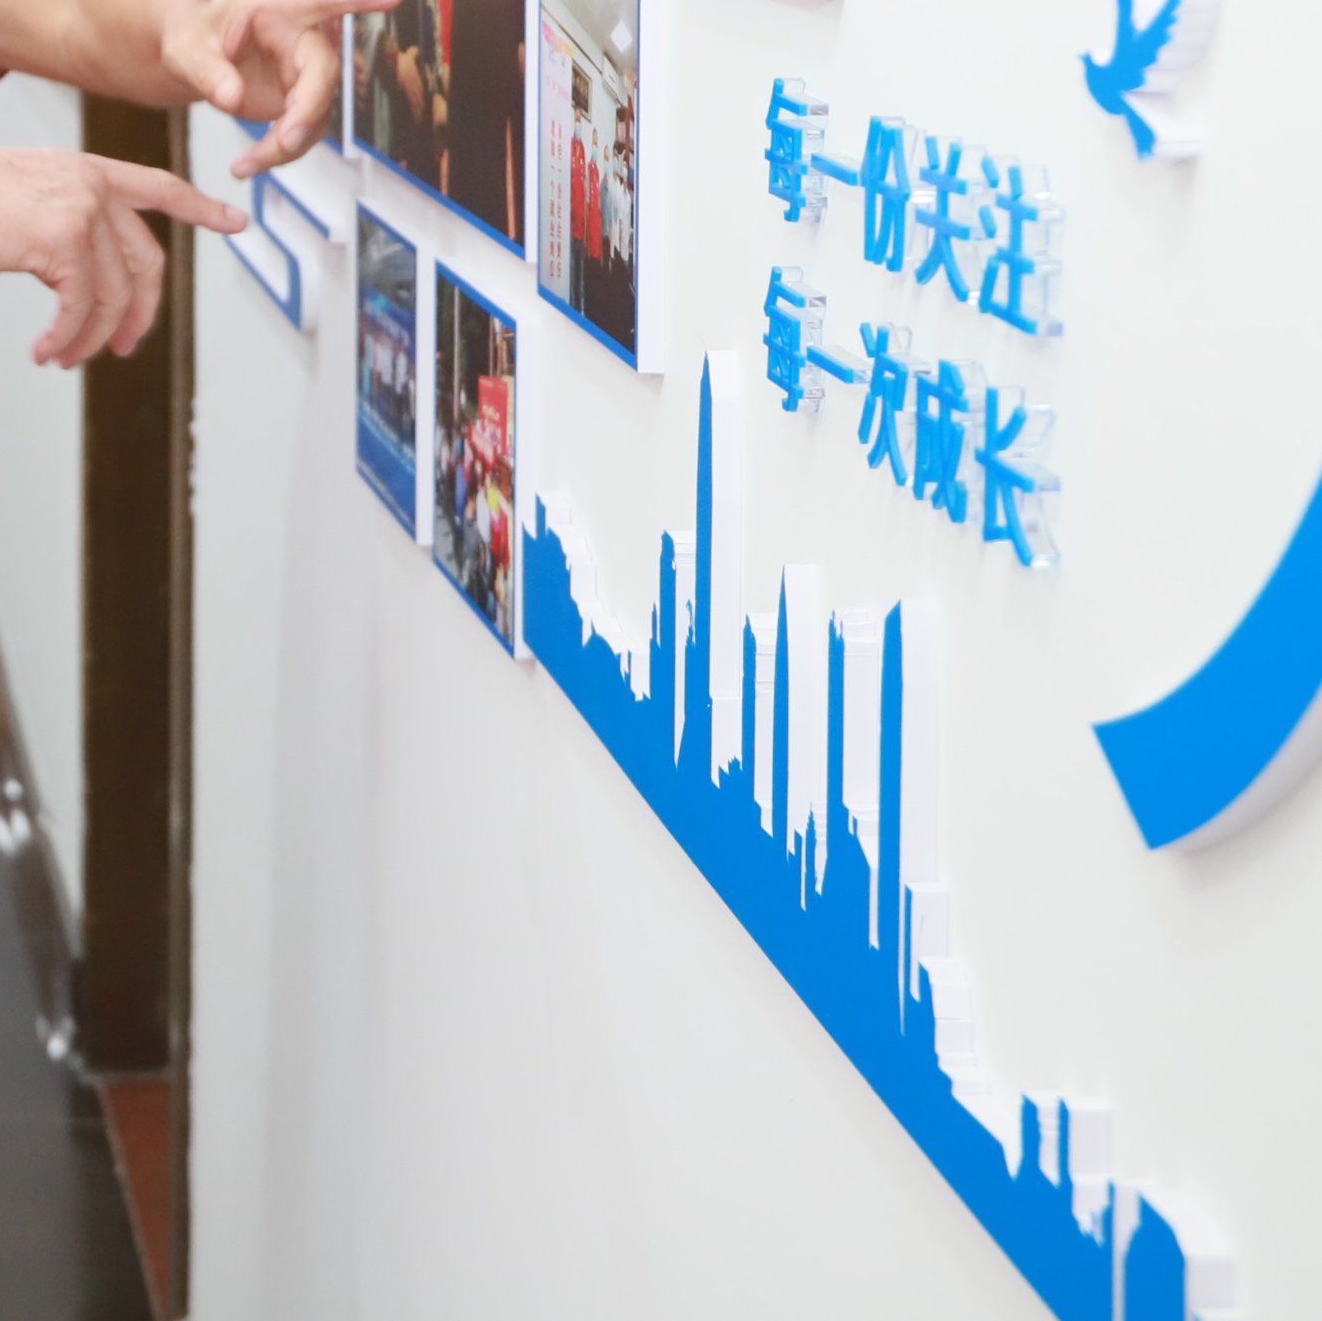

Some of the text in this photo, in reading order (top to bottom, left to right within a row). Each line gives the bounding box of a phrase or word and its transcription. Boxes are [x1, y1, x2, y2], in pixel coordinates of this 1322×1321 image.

[764, 78, 1038, 335] 每一份关注
[763, 266, 1036, 566] 每一次成长
